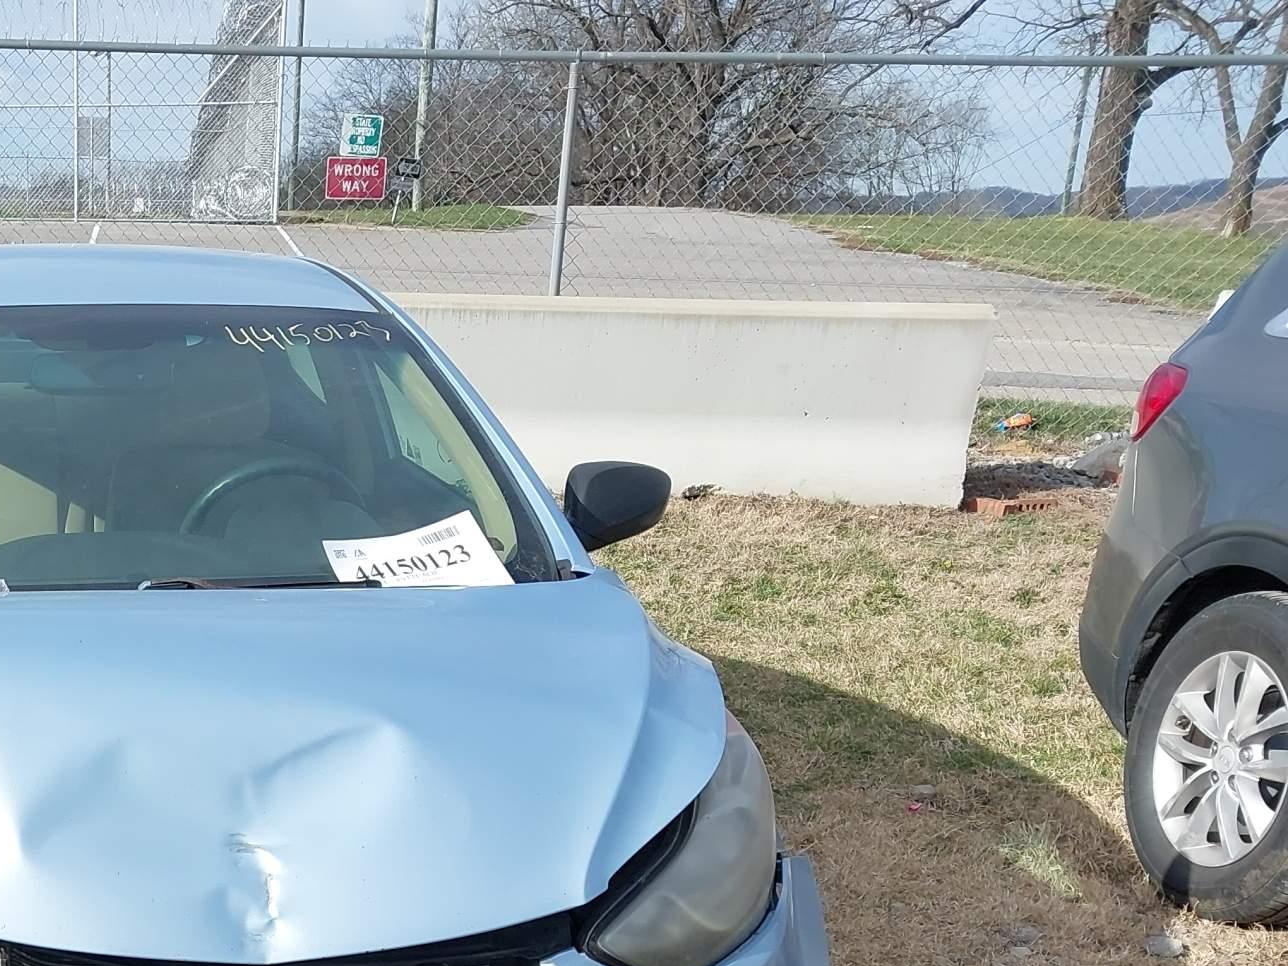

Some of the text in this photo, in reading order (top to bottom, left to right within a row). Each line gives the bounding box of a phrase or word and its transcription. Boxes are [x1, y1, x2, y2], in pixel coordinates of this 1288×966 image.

[334, 163, 380, 177] WRONG
[342, 180, 369, 193] WAY
[355, 544, 472, 581] 44150123
